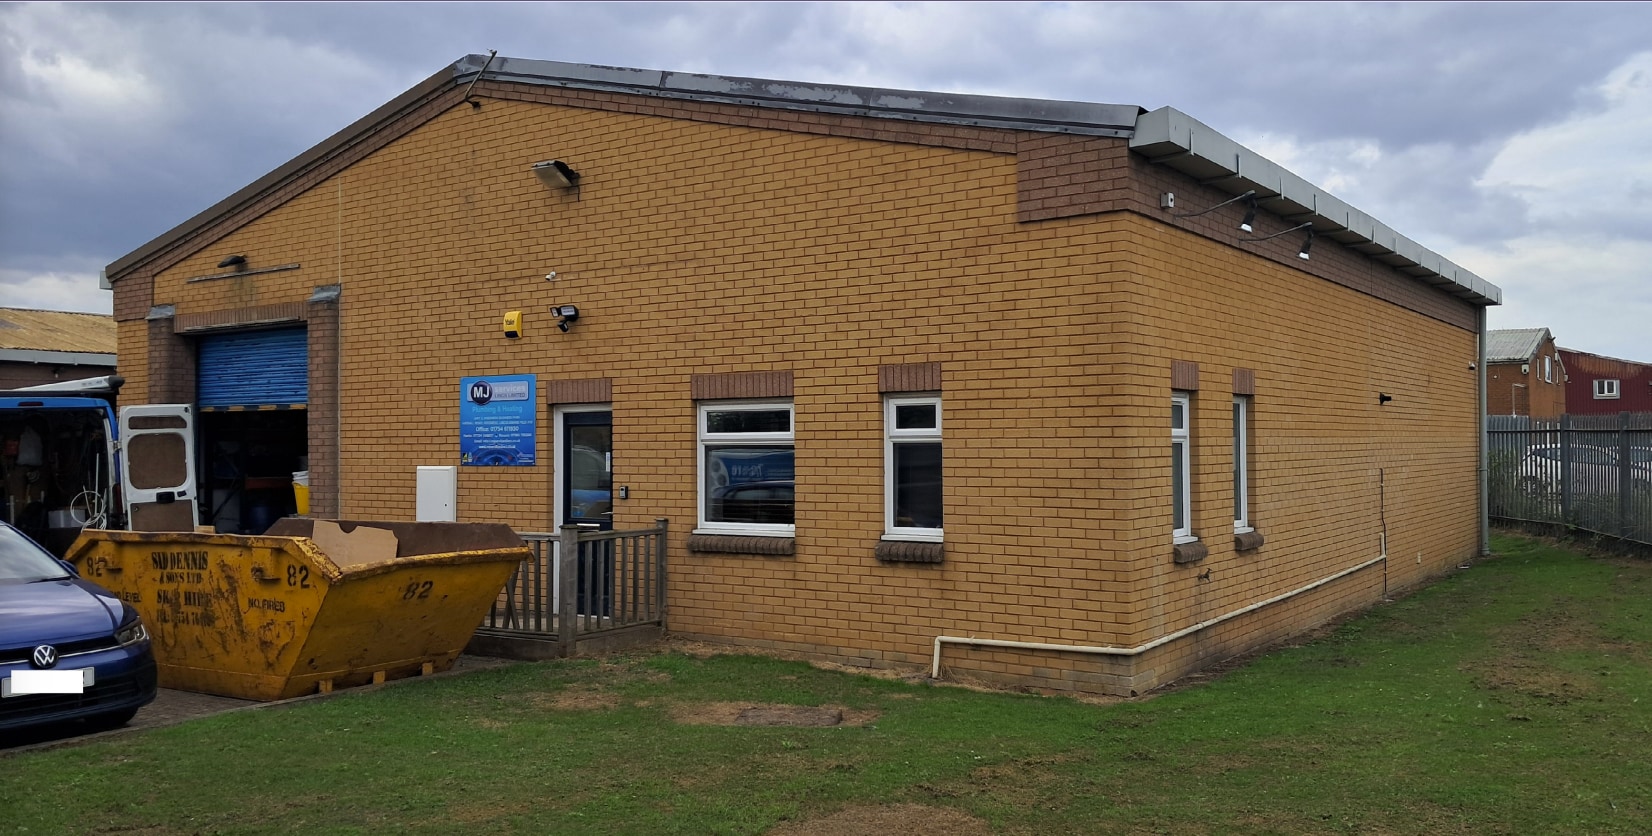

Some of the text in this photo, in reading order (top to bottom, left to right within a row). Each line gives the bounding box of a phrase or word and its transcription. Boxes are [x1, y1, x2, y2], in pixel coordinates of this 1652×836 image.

[473, 384, 526, 398] MJ services
[472, 406, 496, 414] Plumbing
[502, 404, 523, 413] Heating
[151, 551, 208, 570] SID DENNIS
[166, 571, 185, 584] SONS
[186, 572, 203, 584] LTD
[287, 563, 311, 589] 82
[402, 580, 434, 601] 82
